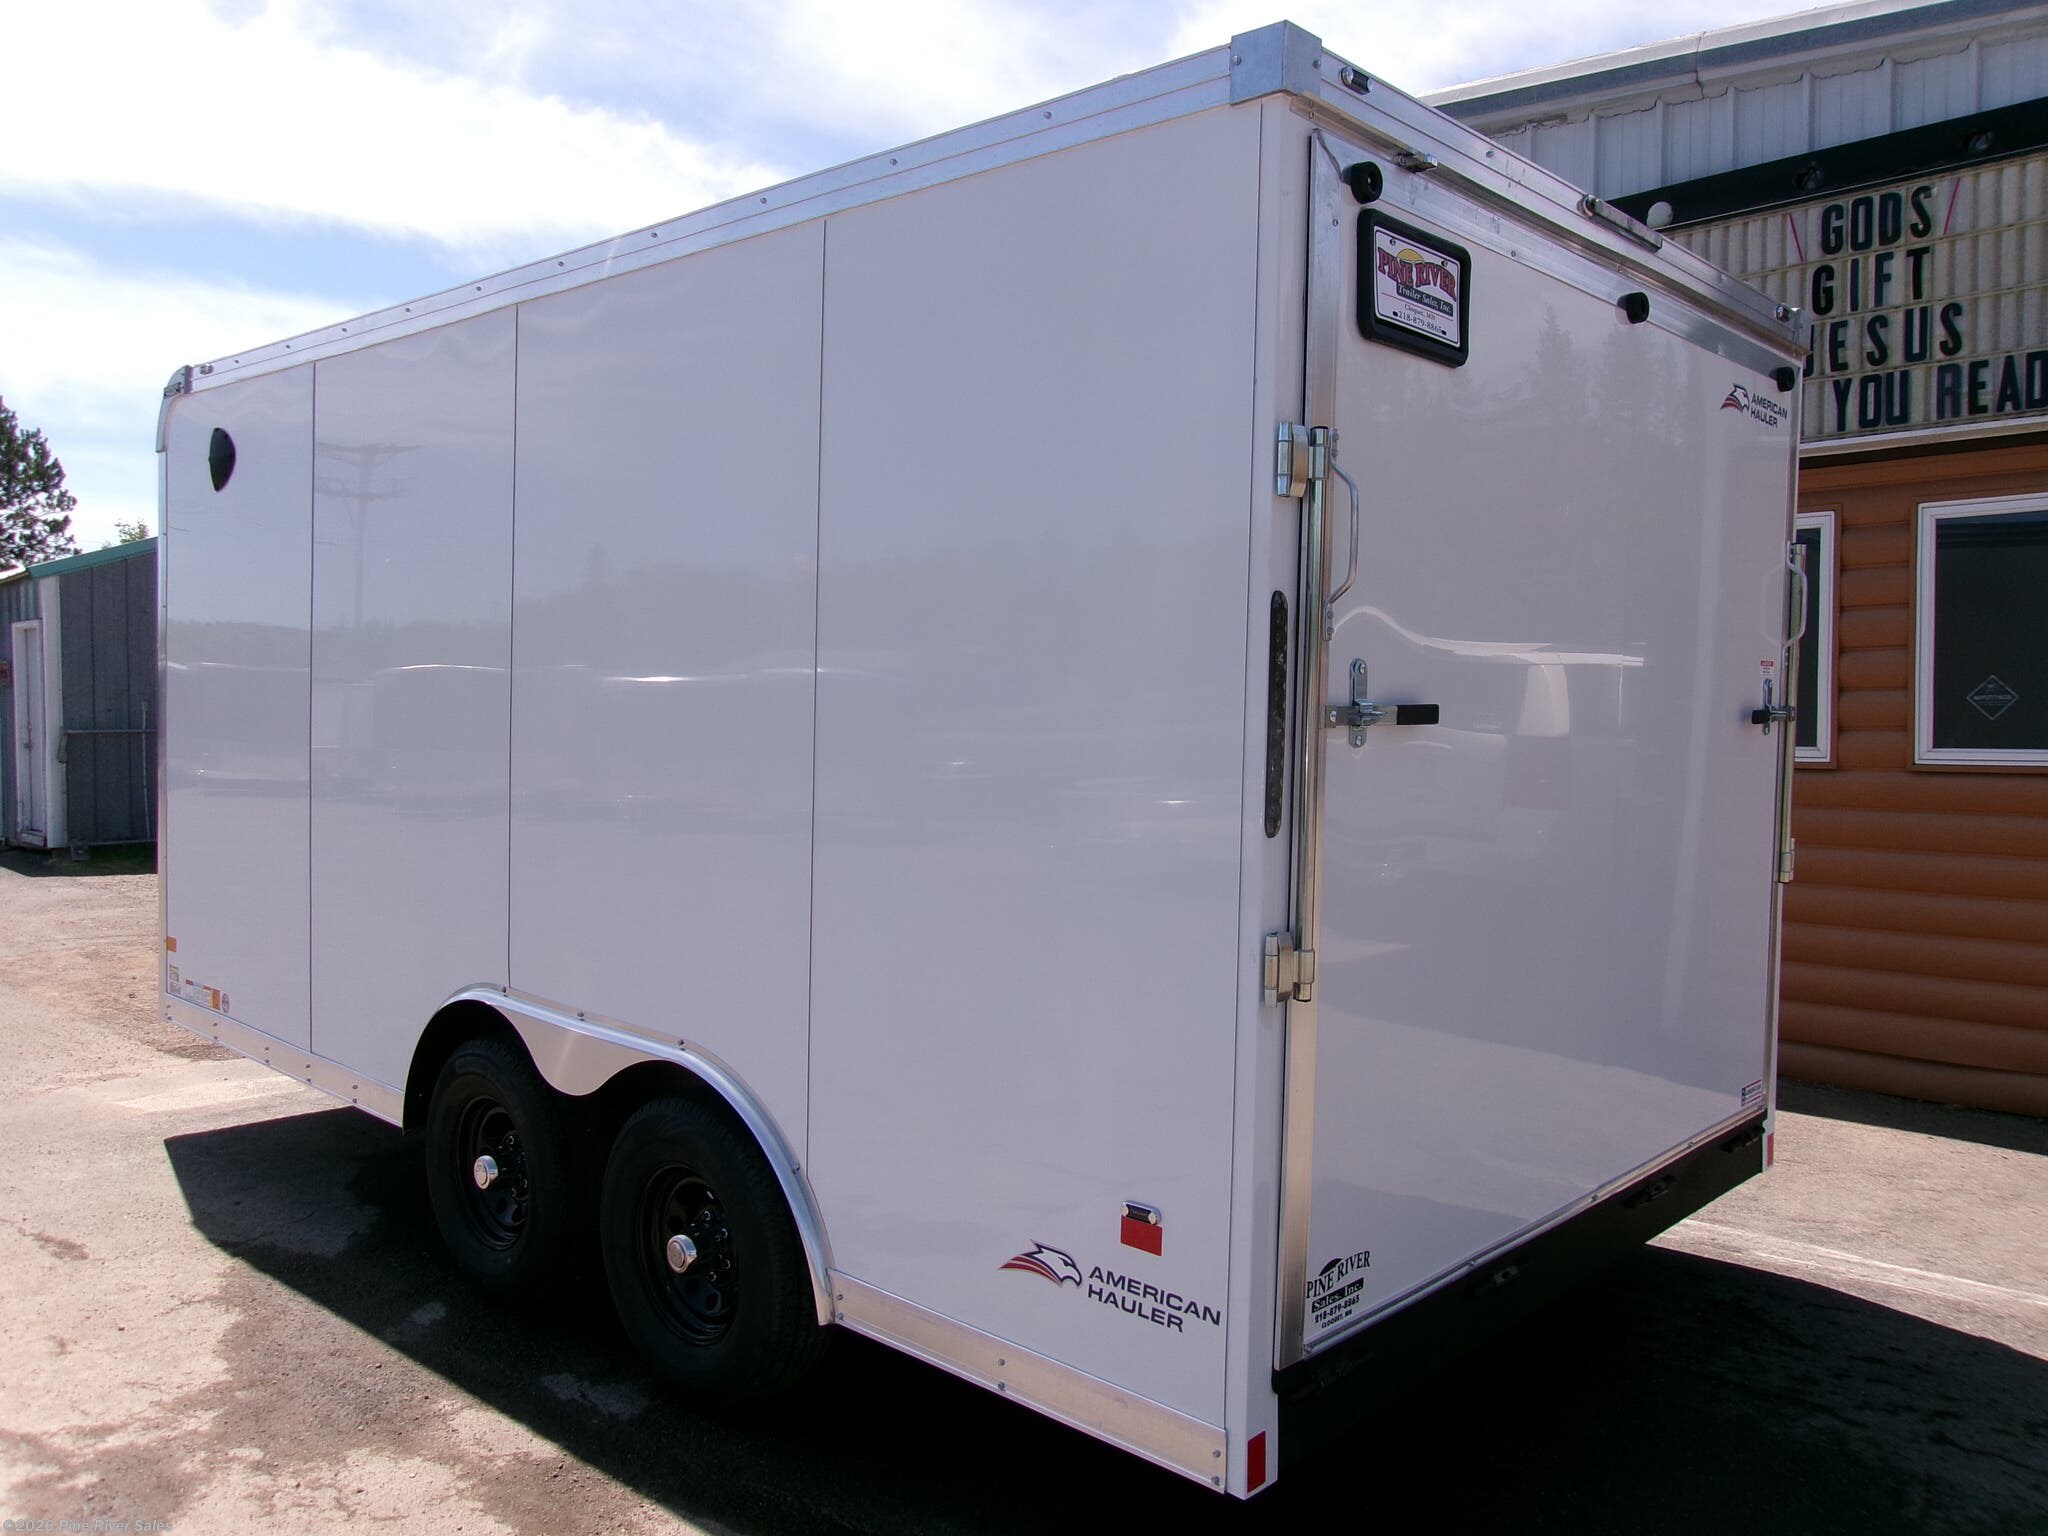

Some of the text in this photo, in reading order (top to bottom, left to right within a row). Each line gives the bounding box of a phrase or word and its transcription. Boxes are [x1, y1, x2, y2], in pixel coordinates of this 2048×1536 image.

[1821, 186, 1933, 255] GODS
[1378, 247, 1458, 302] PINE RIVER
[1398, 284, 1421, 300] Trailer
[1812, 248, 1931, 316] GIFT
[1750, 407, 1778, 428] HAULER
[1751, 393, 1788, 419] AMERICAN
[1833, 350, 2048, 433] YOU READ
[1088, 1266, 1222, 1326] AMERICAN
[1306, 1250, 1370, 1299] PINE RIVER
[1087, 1284, 1184, 1333] HAULER
